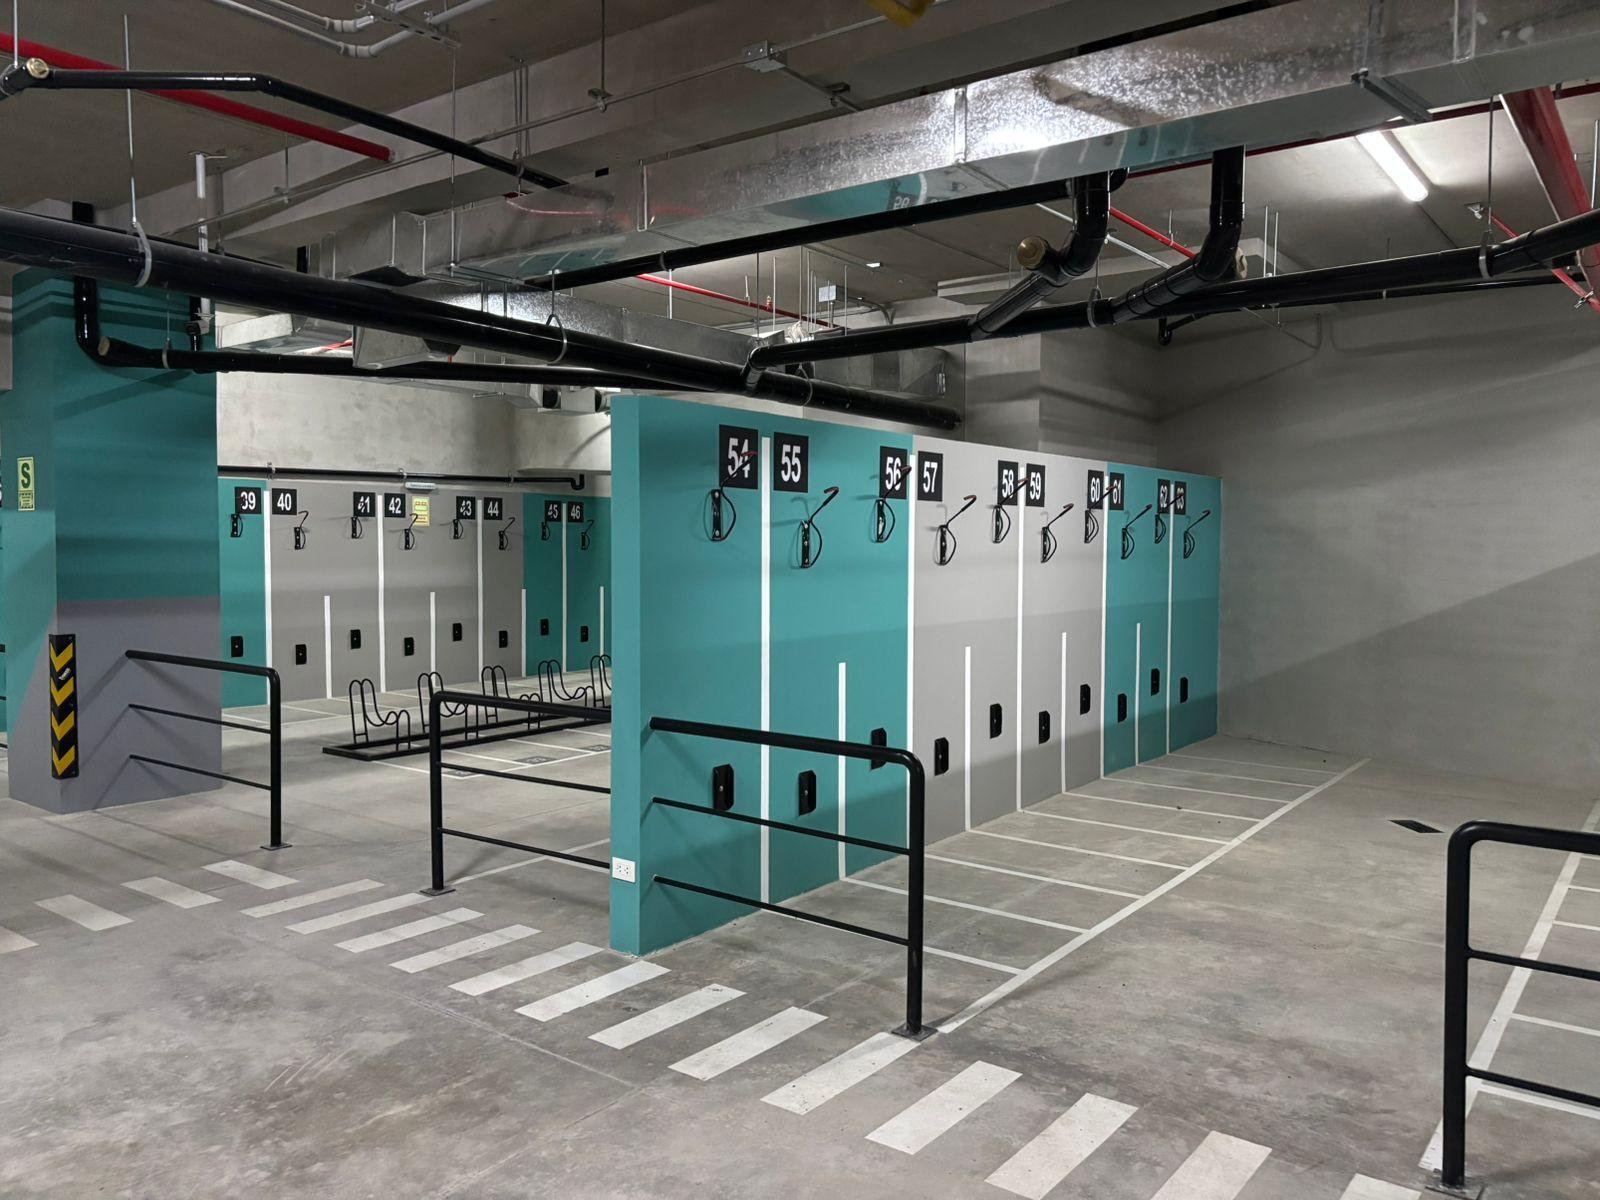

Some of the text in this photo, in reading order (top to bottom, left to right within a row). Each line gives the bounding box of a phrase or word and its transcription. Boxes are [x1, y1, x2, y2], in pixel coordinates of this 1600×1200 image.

[728, 437, 751, 479] 54
[781, 444, 801, 483] 55
[21, 462, 30, 489] S
[885, 456, 901, 491] 56
[923, 461, 938, 493] 57
[1002, 469, 1014, 499] 58
[1029, 471, 1042, 500] 59
[241, 491, 256, 510] 39
[277, 493, 292, 511] 40
[1091, 477, 1100, 503] 60
[1112, 479, 1121, 503] 61
[1160, 484, 1167, 508] 62
[358, 496, 370, 513] 41
[388, 497, 402, 514] 42
[460, 500, 472, 516] 43
[487, 501, 499, 516] 44
[570, 505, 580, 519] 46
